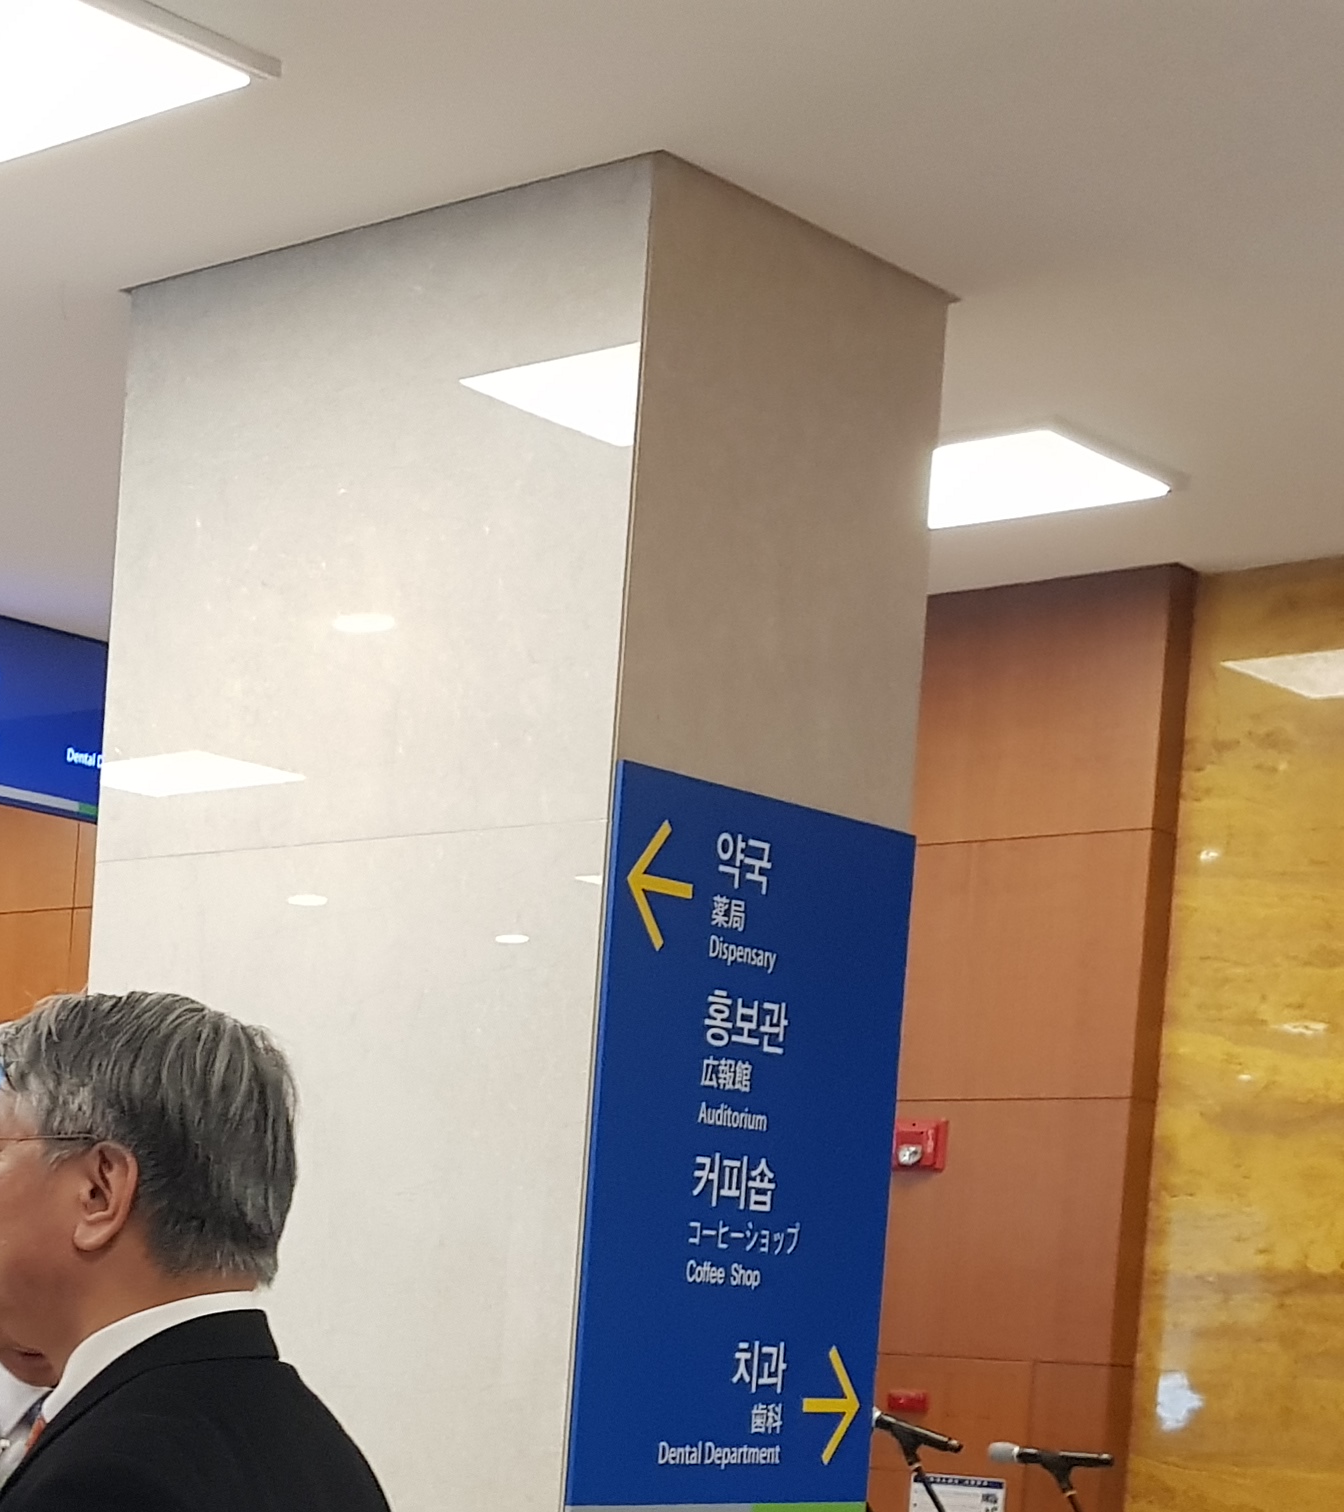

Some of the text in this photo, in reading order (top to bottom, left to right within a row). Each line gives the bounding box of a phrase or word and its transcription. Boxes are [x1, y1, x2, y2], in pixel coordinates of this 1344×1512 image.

[66, 747, 97, 767] Dental
[716, 832, 772, 895] 약국
[709, 935, 777, 974] Dispensary
[704, 989, 789, 1055] 홍보관
[700, 1057, 752, 1093] 広報館
[697, 1102, 768, 1132] Auditorium
[692, 1152, 776, 1212] 커피숍
[687, 1220, 801, 1256] コーヒーショップ
[686, 1260, 761, 1290] Coffee Shop
[731, 1340, 787, 1394] 치과
[750, 1403, 782, 1435] 歯科
[657, 1441, 780, 1470] Dental Department
